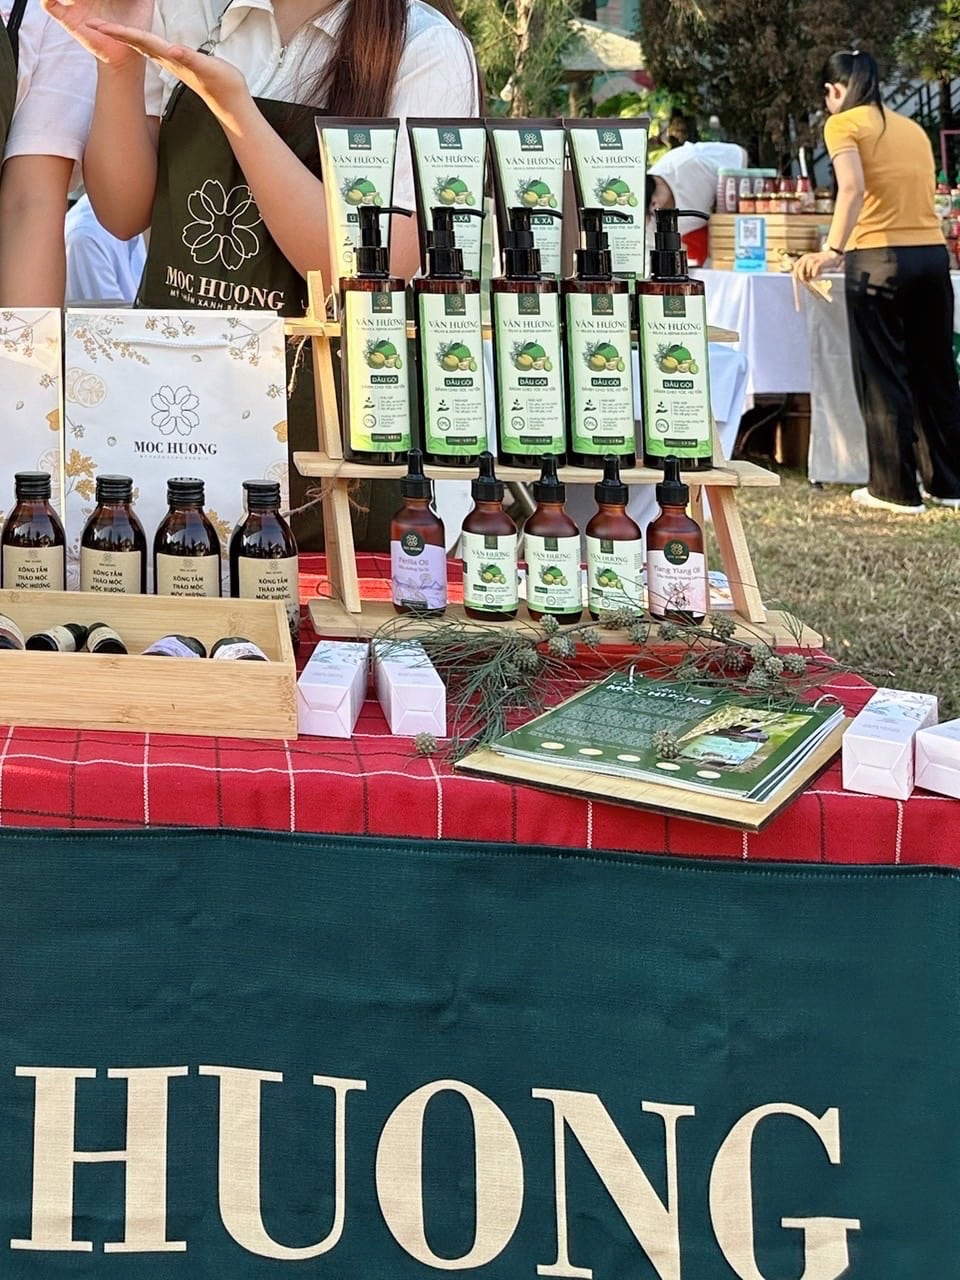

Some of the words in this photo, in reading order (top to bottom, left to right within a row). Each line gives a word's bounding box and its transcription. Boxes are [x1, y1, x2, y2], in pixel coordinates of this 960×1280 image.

[165, 265, 194, 293] MOC
[197, 276, 285, 310] HUONG
[134, 440, 163, 453] MOC
[167, 441, 218, 455] HUONG
[10, 1066, 861, 1280] HUONG
